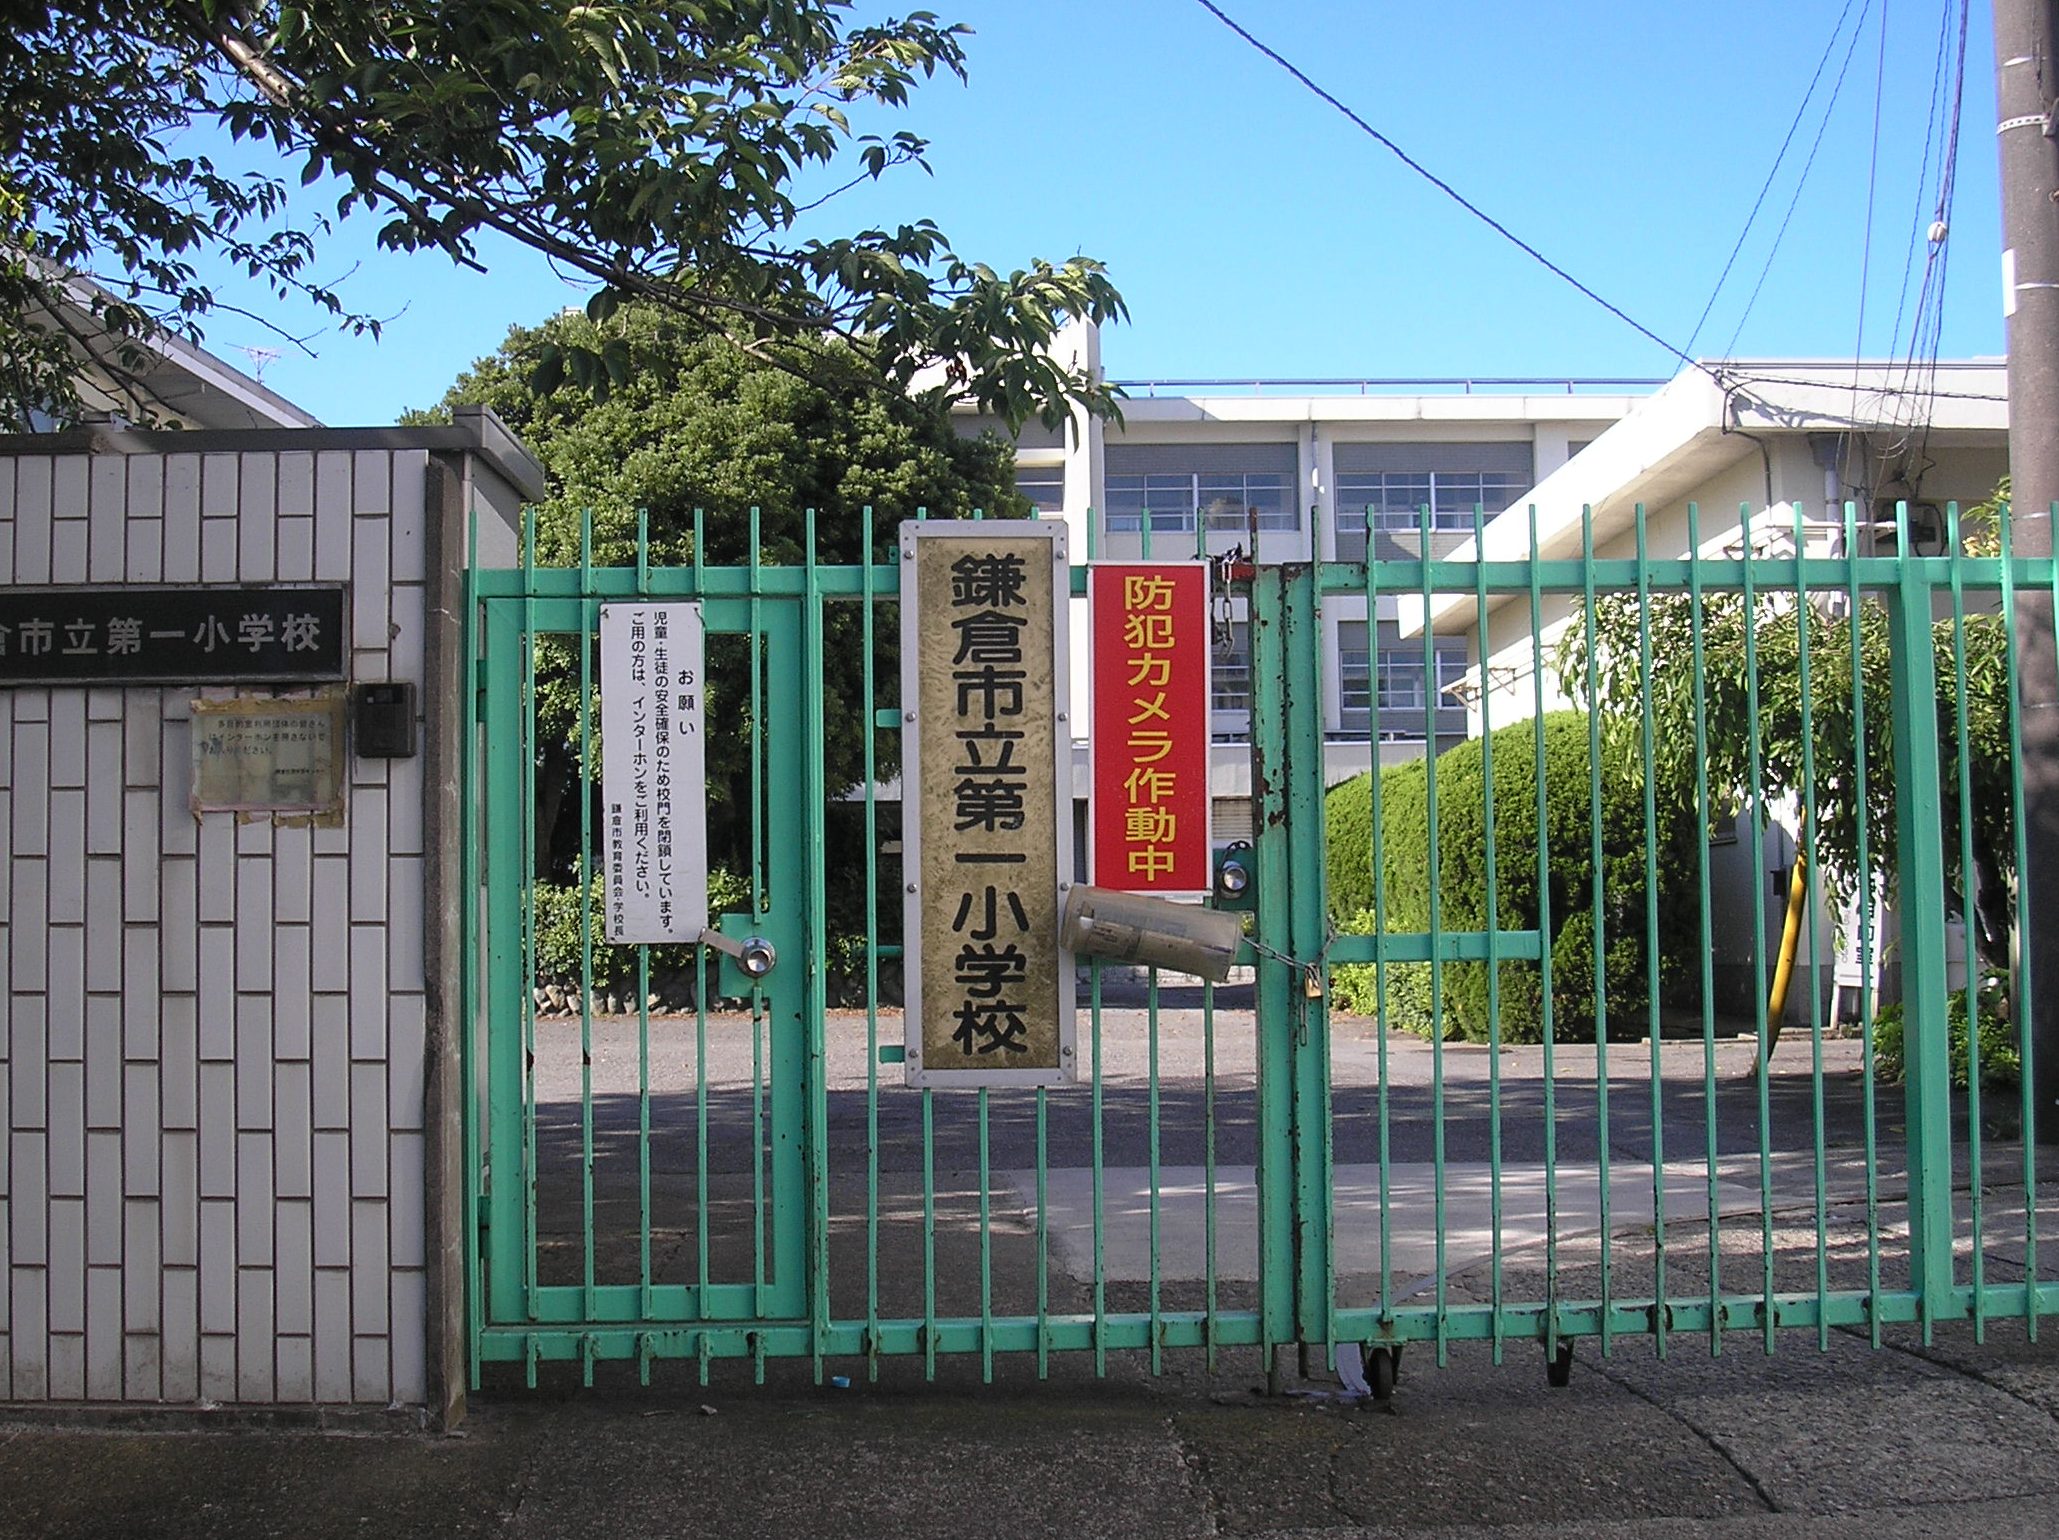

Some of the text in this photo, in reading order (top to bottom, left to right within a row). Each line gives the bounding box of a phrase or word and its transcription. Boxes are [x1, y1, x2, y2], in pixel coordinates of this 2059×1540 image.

[630, 611, 650, 899] ご用の方は、インターホンをご利用ください。
[653, 611, 674, 935] 児童・生徒の安全確保のため校門を閉鎖しています。
[678, 670, 695, 735] お願い
[951, 553, 1029, 1057] 鎌倉市立第一小学校
[1122, 575, 1178, 882] 防犯カメラ作動中
